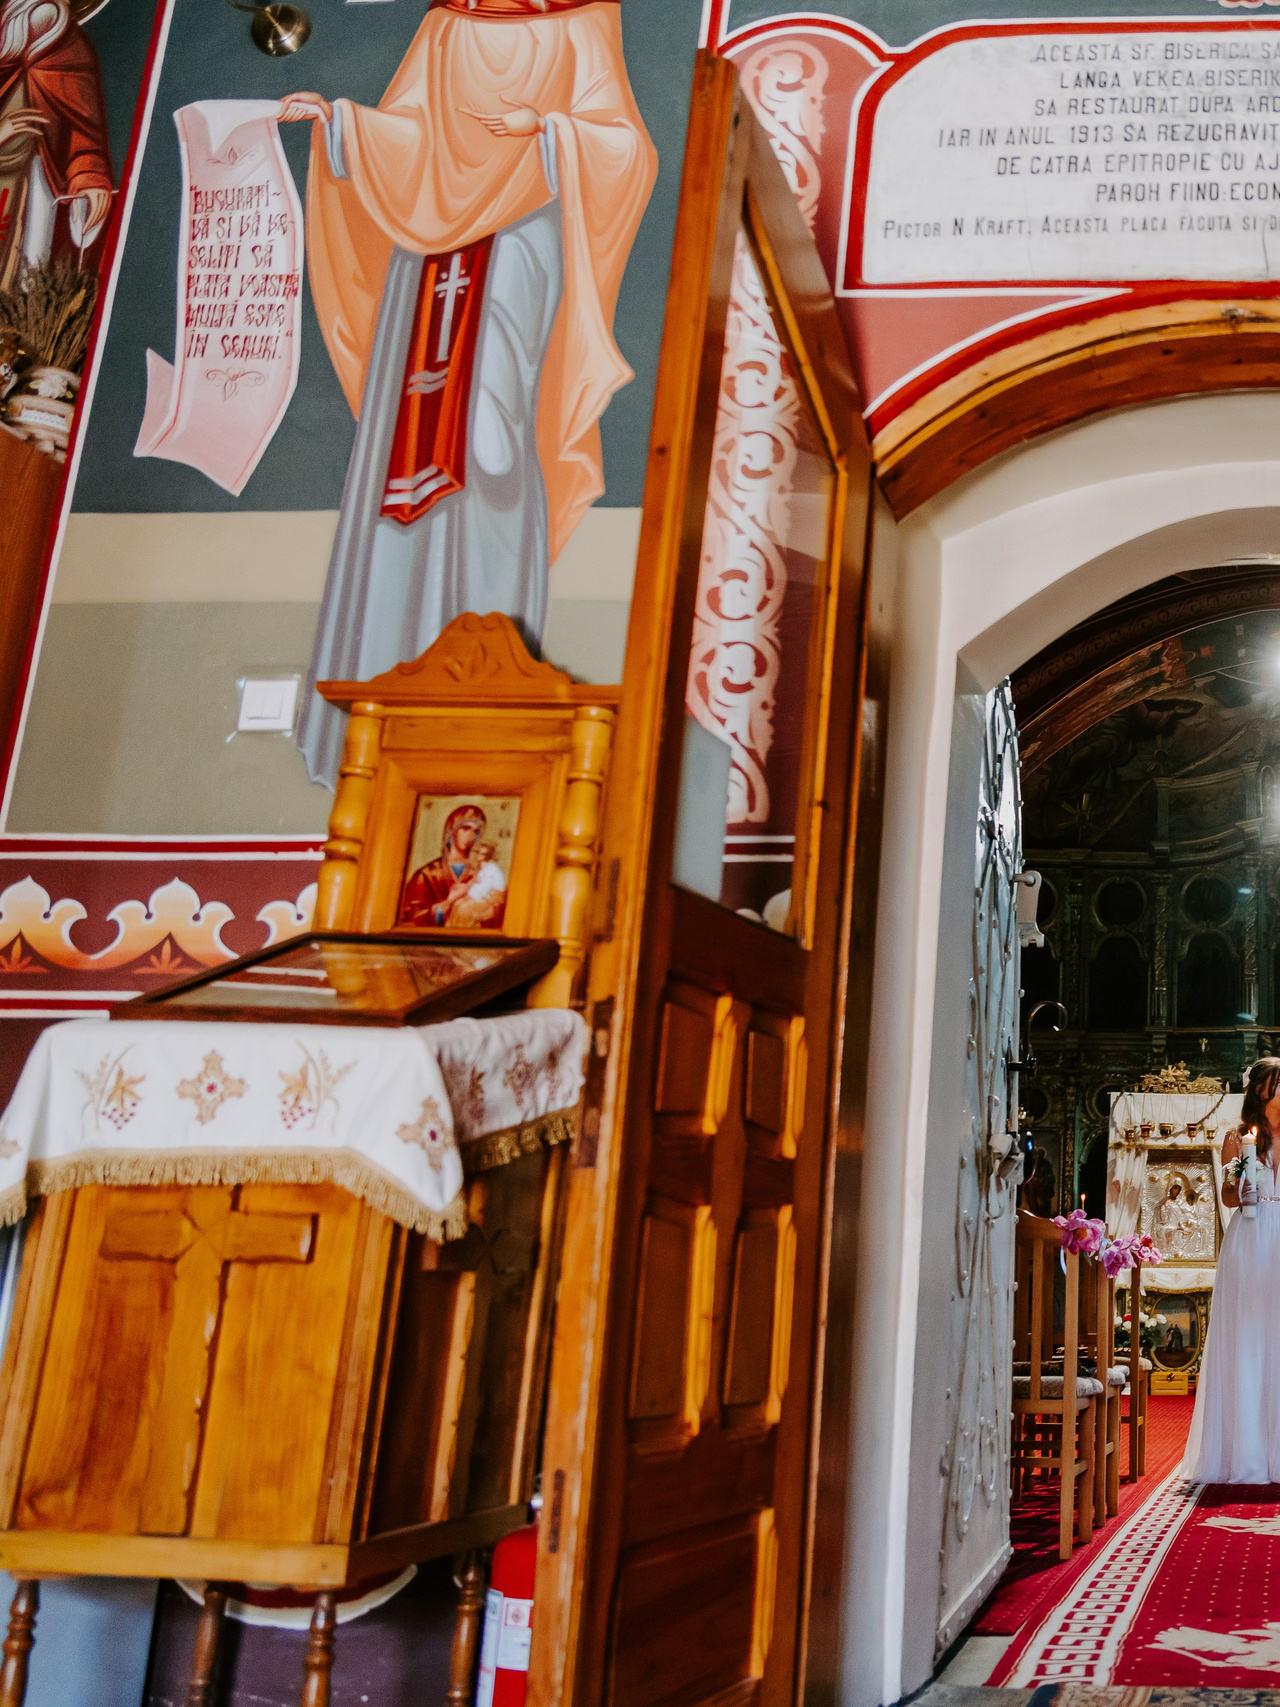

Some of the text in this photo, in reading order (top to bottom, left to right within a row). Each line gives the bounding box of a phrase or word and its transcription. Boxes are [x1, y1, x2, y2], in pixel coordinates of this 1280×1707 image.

[1036, 44, 1121, 62] ACEASTA
[1164, 43, 1251, 60] BISERICA
[1060, 70, 1121, 89] LANGA
[1035, 98, 1057, 116] SA
[1067, 97, 1179, 115] RESTAURAT
[1189, 96, 1234, 113] DUPA
[939, 129, 971, 147] IAR
[979, 128, 997, 146] IN
[1005, 126, 1055, 145] ANUL
[1070, 125, 1114, 144] 1913
[1124, 125, 1148, 143] SA
[1157, 123, 1278, 142] REZUGRAVIT
[996, 156, 1021, 176] DE
[1030, 155, 1092, 174] CATRA
[1105, 153, 1211, 173] EPITROPIE
[1221, 152, 1244, 171] CU
[1096, 183, 1160, 203] PAROH
